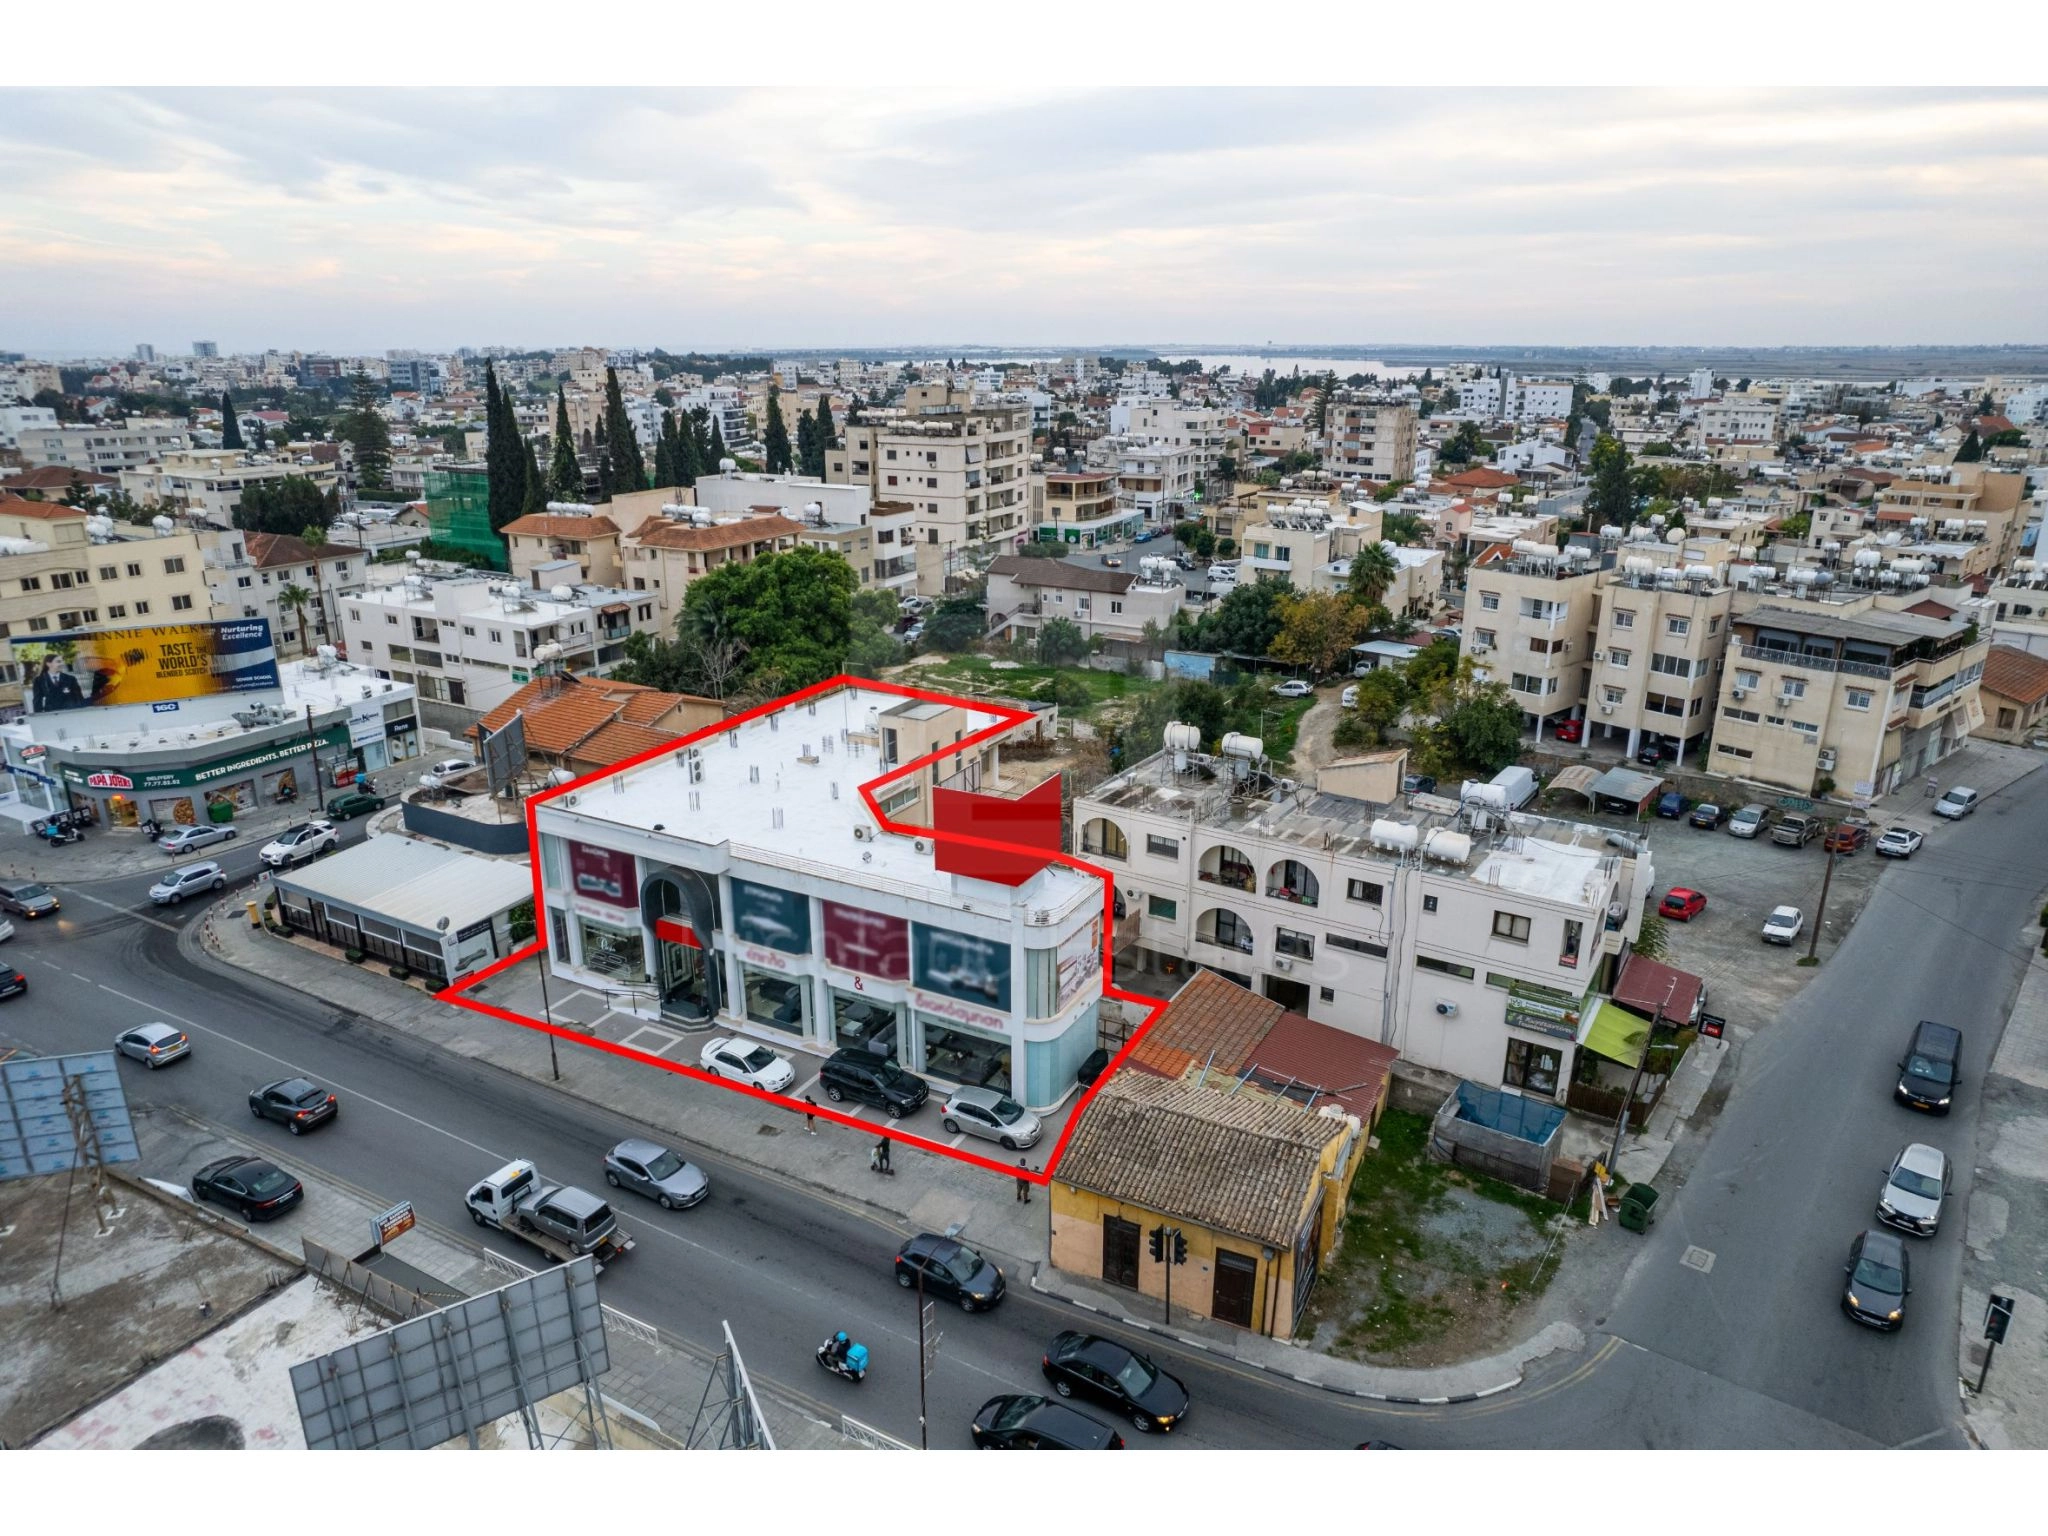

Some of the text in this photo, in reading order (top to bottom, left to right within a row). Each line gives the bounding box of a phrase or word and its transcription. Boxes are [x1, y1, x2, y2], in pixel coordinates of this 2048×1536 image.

[220, 624, 263, 634] Nurturing
[222, 632, 263, 640] Excellence
[159, 642, 193, 656] TASTE
[158, 653, 208, 670] WORLD'S
[194, 739, 330, 781] BETTER INGREDIENTS. BETTER PZZA.
[89, 774, 108, 786] PAPA
[146, 774, 174, 782] DELIVERY
[854, 976, 864, 991] &
